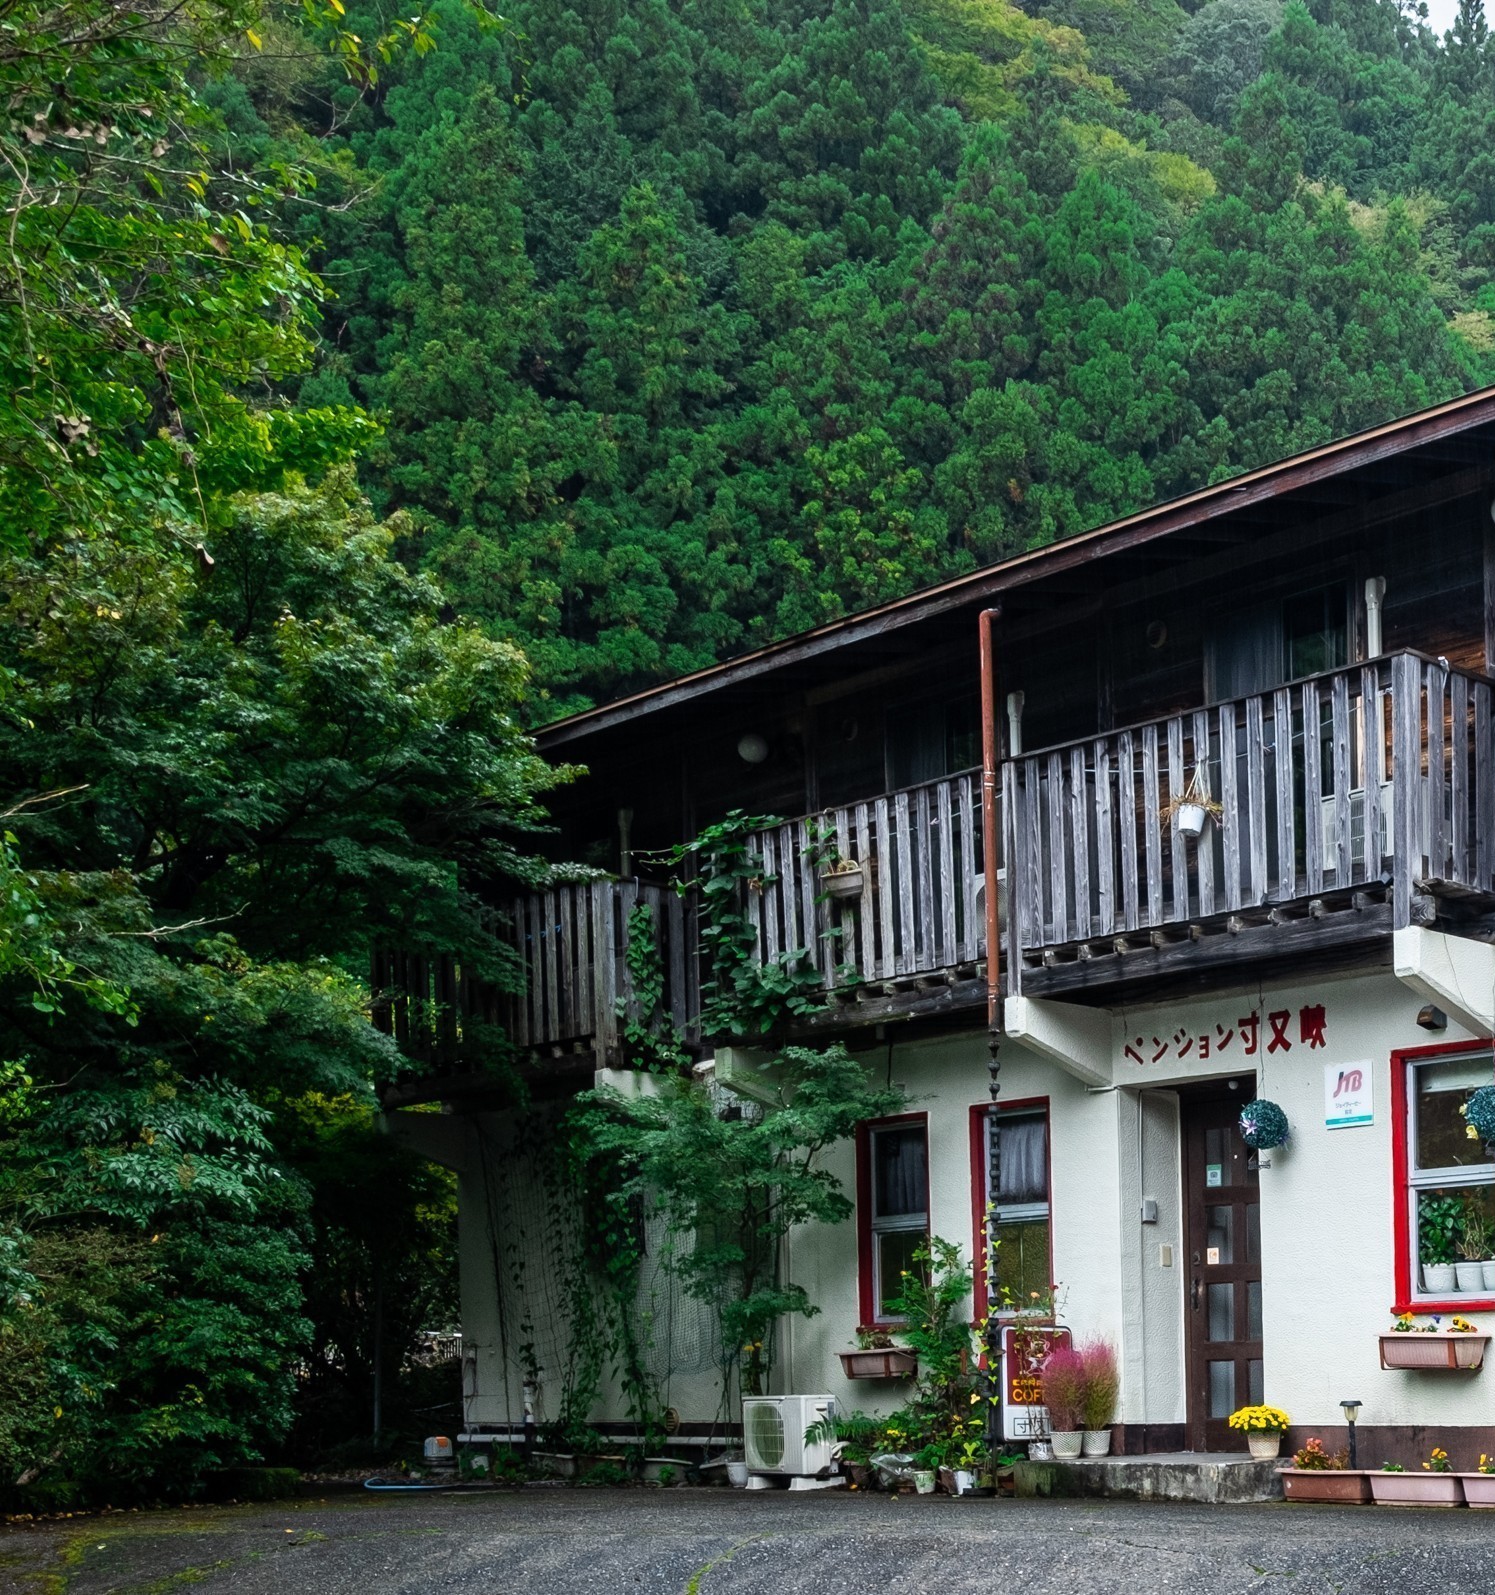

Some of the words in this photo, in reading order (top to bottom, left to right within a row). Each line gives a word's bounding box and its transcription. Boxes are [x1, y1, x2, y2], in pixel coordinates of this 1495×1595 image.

[1124, 1003, 1327, 1065] ペンション寸又峡
[1333, 1069, 1363, 1098] JTB
[1012, 1388, 1046, 1402] COF
